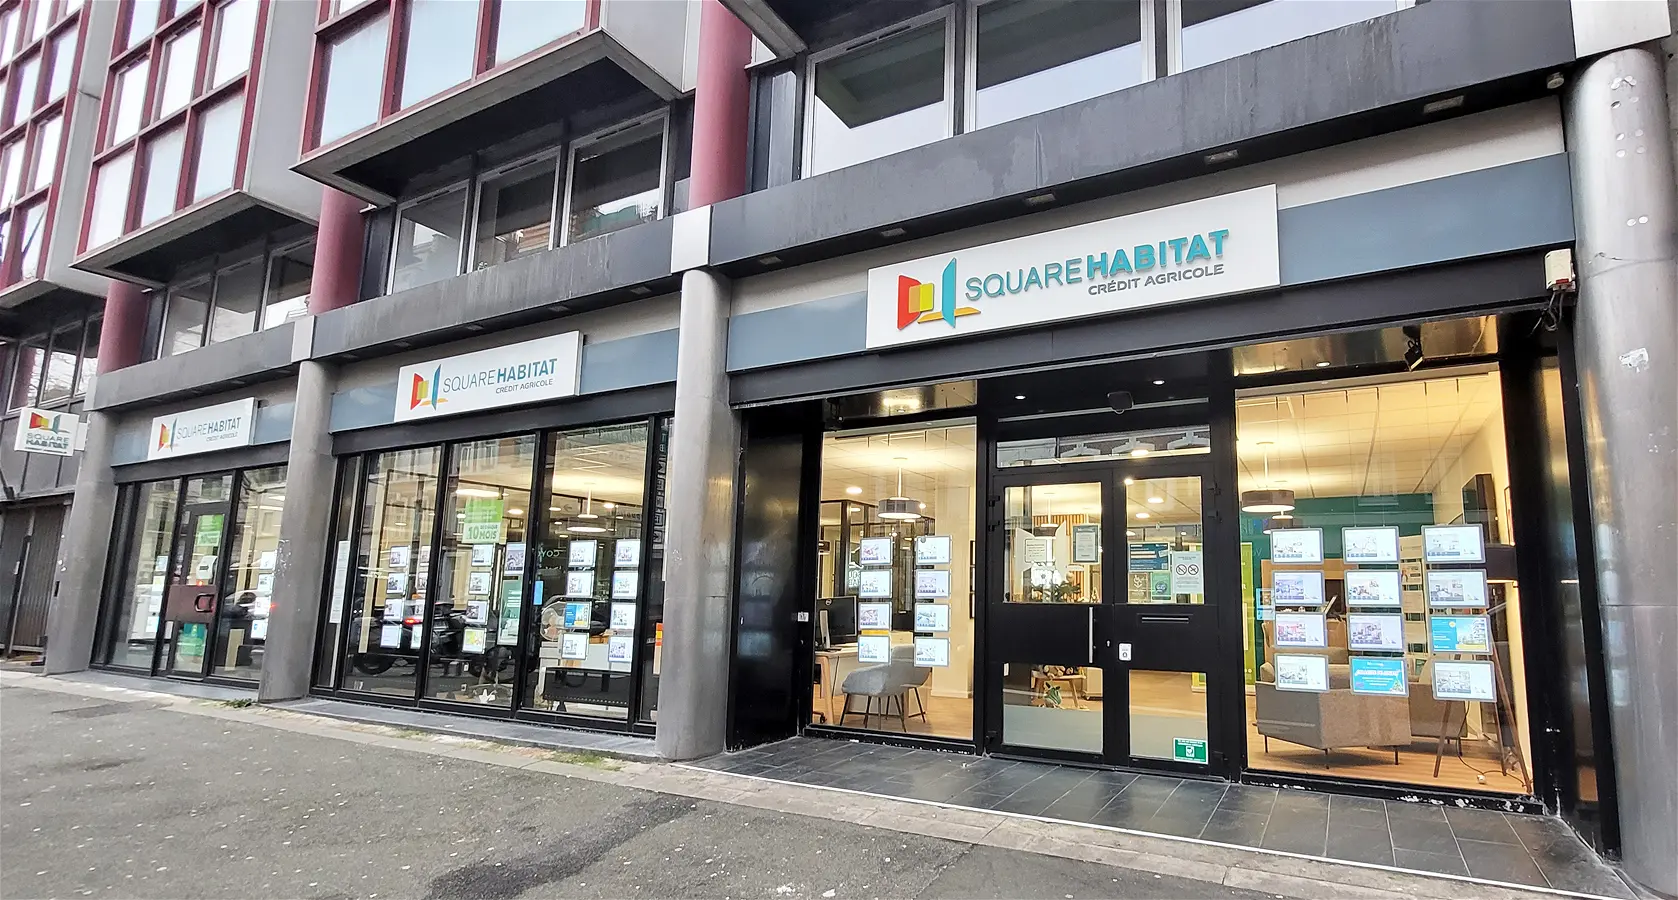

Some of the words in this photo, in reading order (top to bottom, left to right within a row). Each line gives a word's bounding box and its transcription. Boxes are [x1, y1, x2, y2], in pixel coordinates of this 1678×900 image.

[965, 257, 1082, 301] SQUARE
[1086, 229, 1229, 280] HABITAT
[1088, 277, 1140, 295] CRÉDIT
[1144, 264, 1224, 287] AGRICOLE
[519, 379, 553, 390] AGRICOLE
[26, 432, 69, 443] SQUARE
